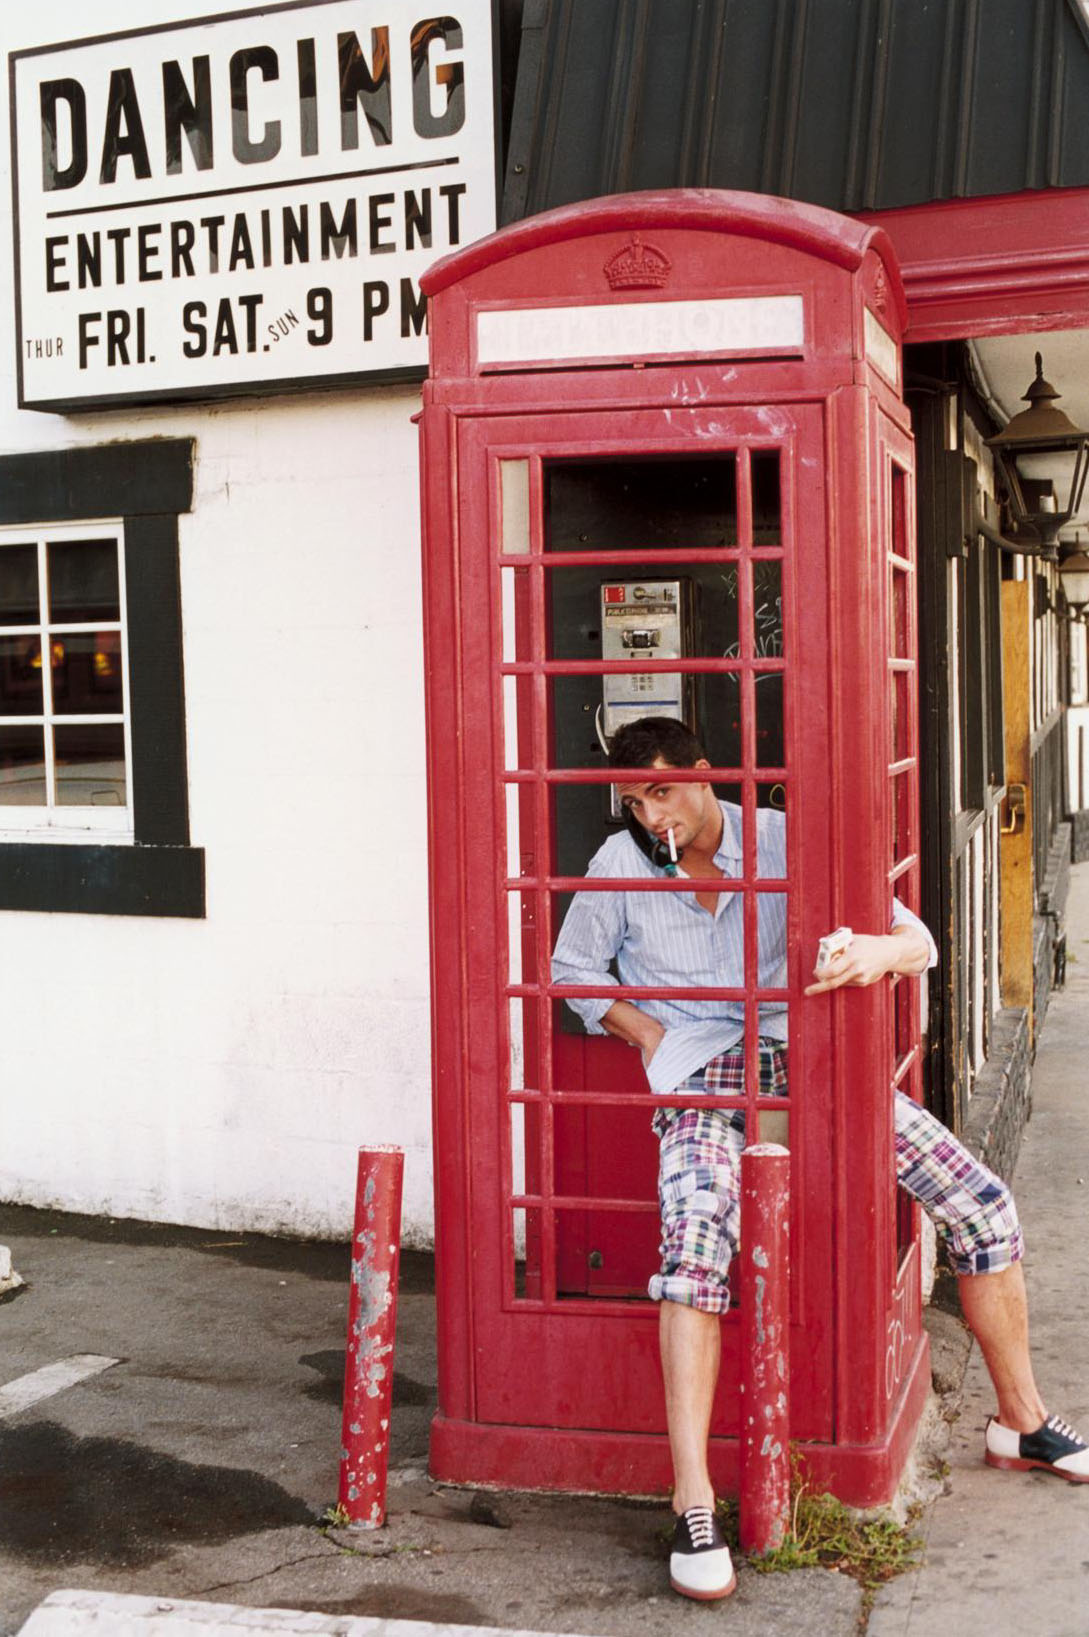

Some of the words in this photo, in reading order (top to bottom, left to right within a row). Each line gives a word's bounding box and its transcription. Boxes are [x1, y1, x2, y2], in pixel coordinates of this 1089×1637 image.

[39, 15, 466, 193] DANCING
[45, 182, 467, 293] ENTERTAINMENT
[26, 337, 64, 359] THUR
[78, 306, 156, 370] FRI.
[182, 293, 270, 359] SAT.
[267, 308, 300, 342] SUN
[306, 286, 334, 347] 9
[362, 276, 429, 342] PM
